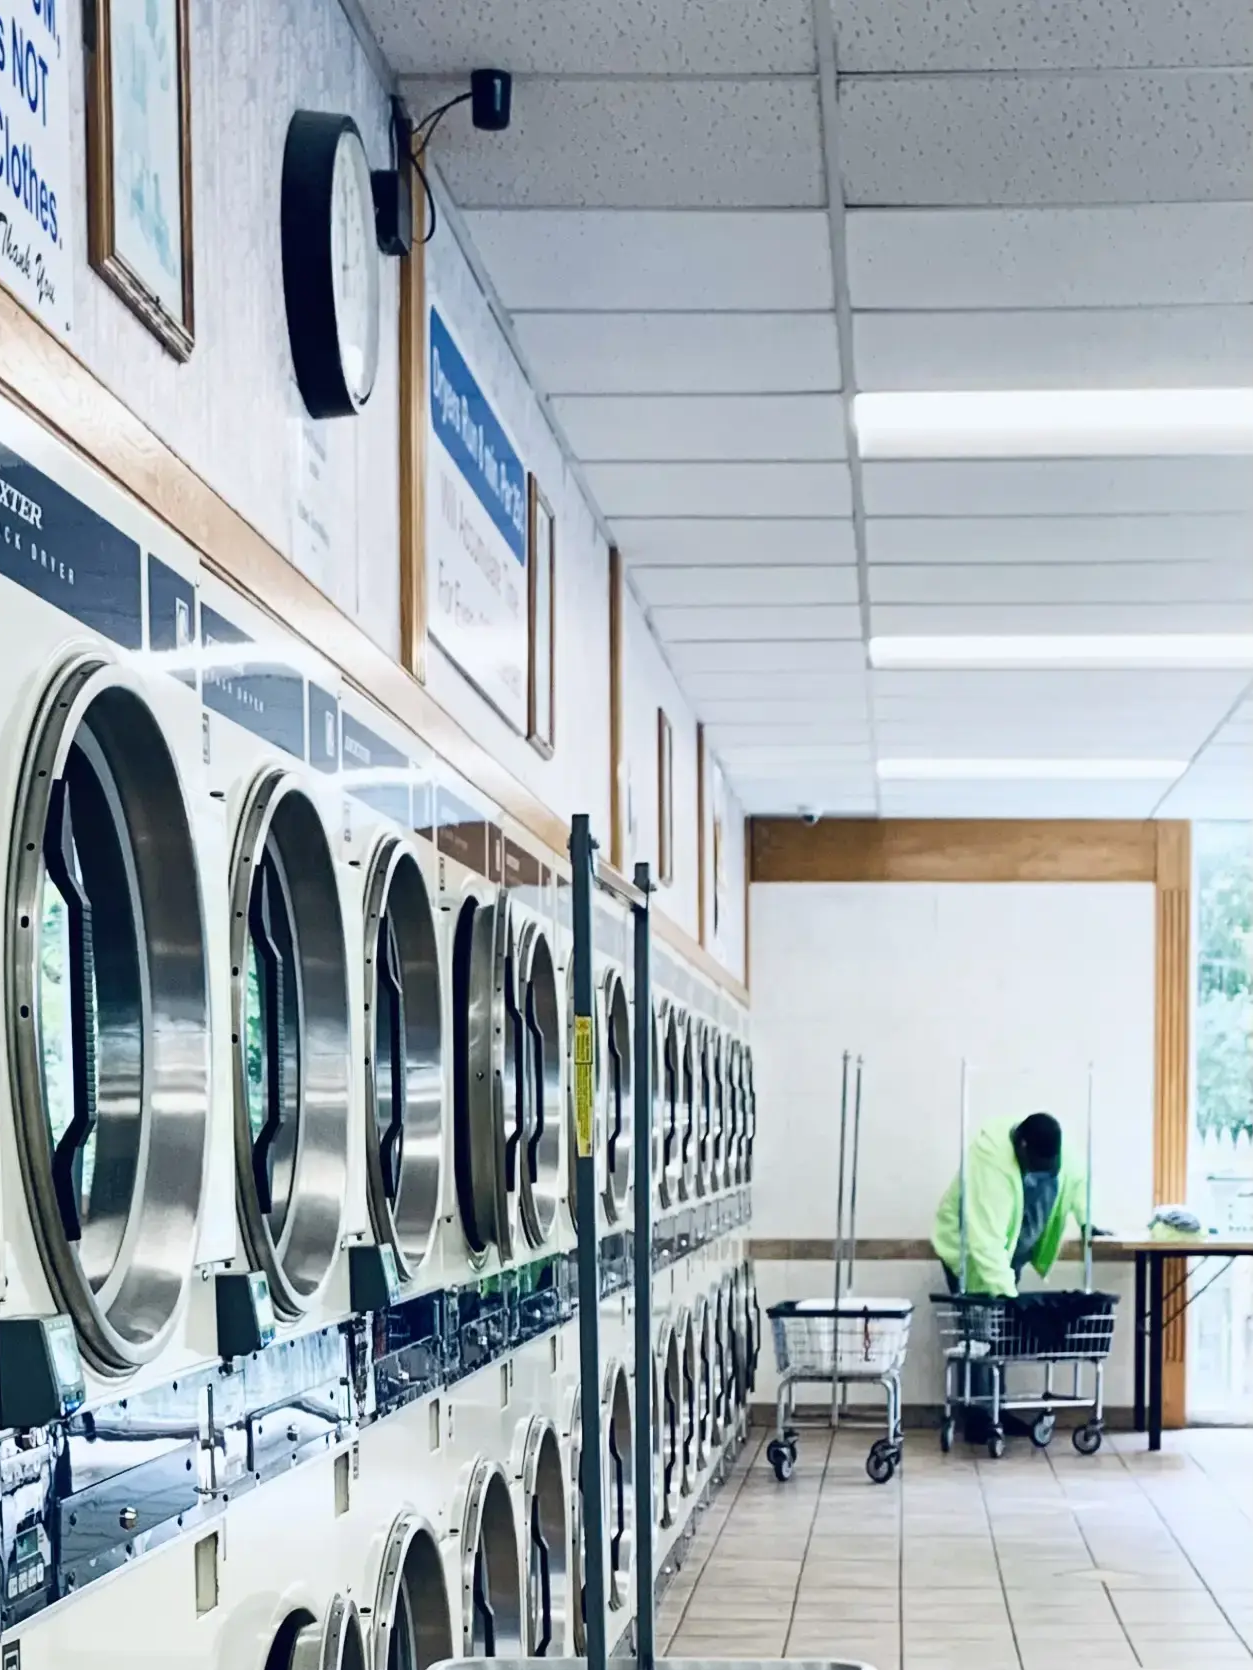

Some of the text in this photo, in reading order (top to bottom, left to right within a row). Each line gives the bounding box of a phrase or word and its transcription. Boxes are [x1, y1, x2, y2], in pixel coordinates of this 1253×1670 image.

[12, 16, 48, 127] NOT
[35, 252, 55, 305] You
[31, 543, 74, 585] DRYER
